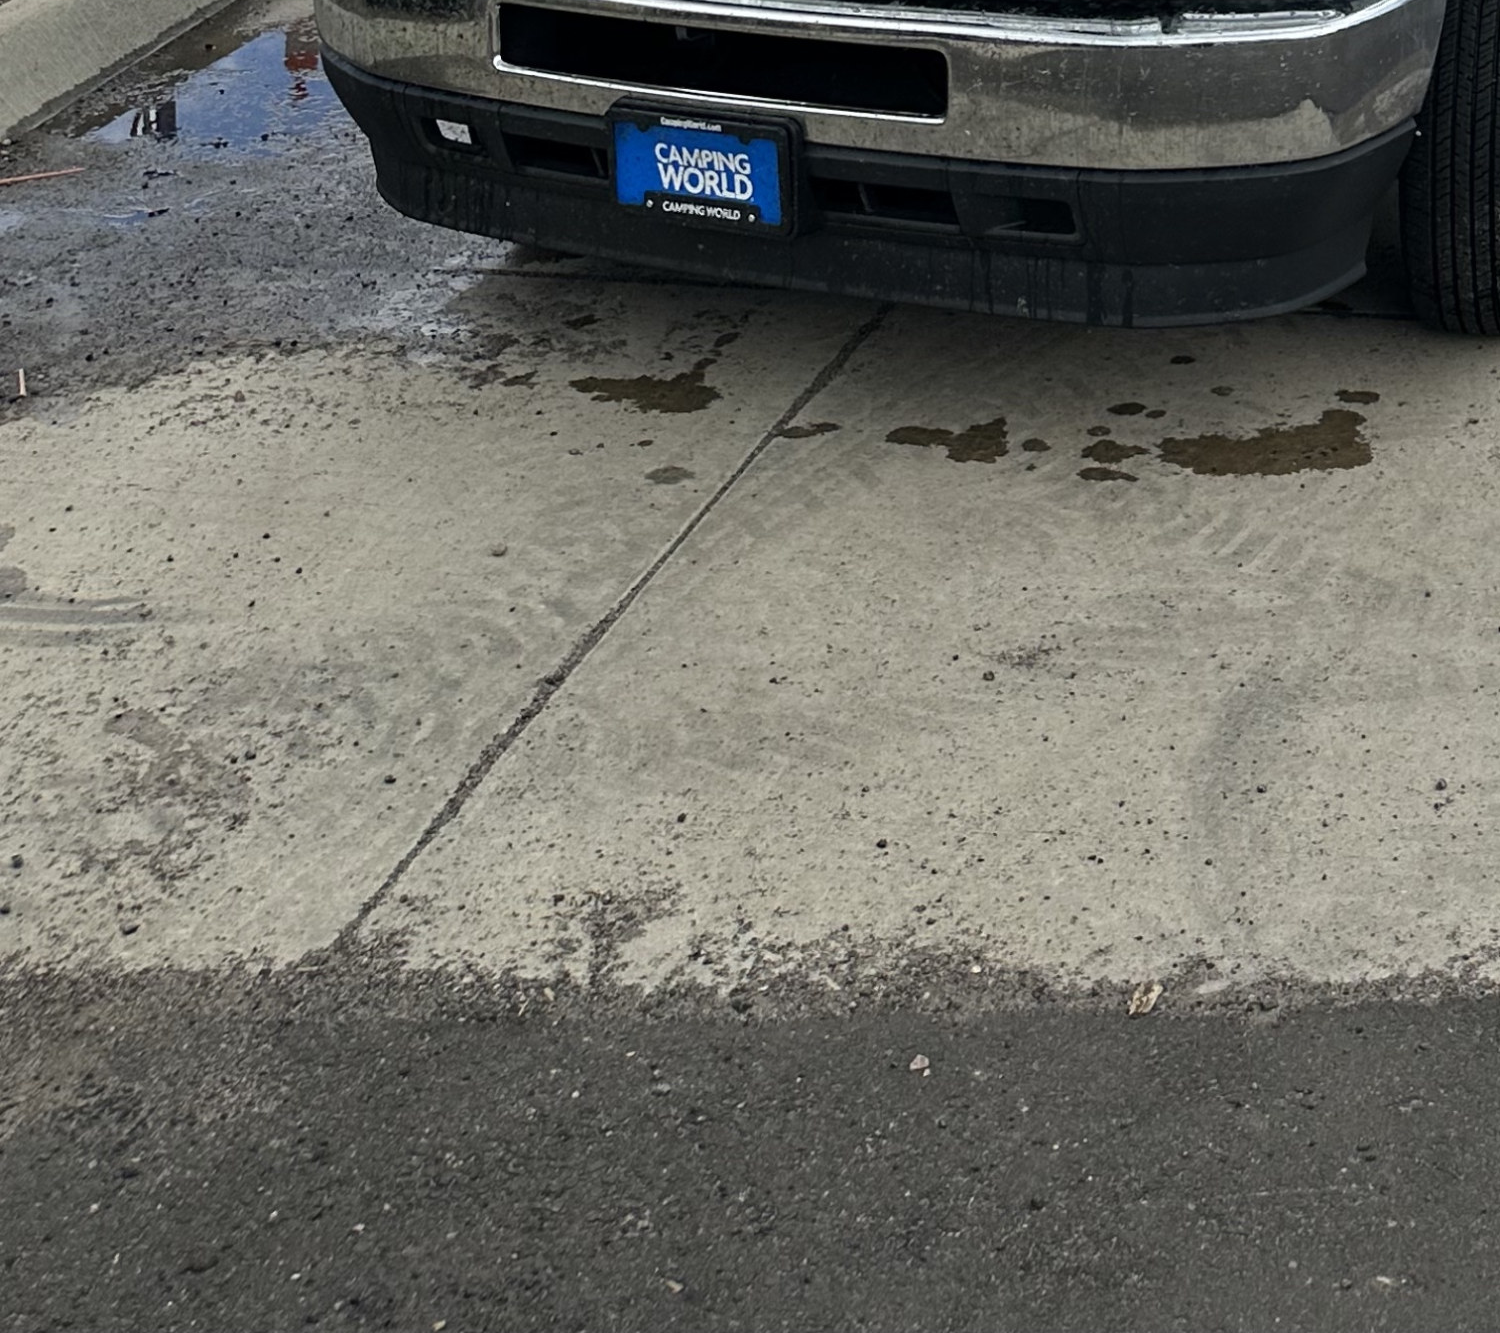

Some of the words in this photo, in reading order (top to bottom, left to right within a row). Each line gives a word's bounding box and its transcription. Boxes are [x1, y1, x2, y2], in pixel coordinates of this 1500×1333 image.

[654, 142, 751, 175] CAMPING
[656, 162, 754, 201] WORLD
[662, 200, 705, 217] CAMPING
[706, 206, 741, 221] WORLD
